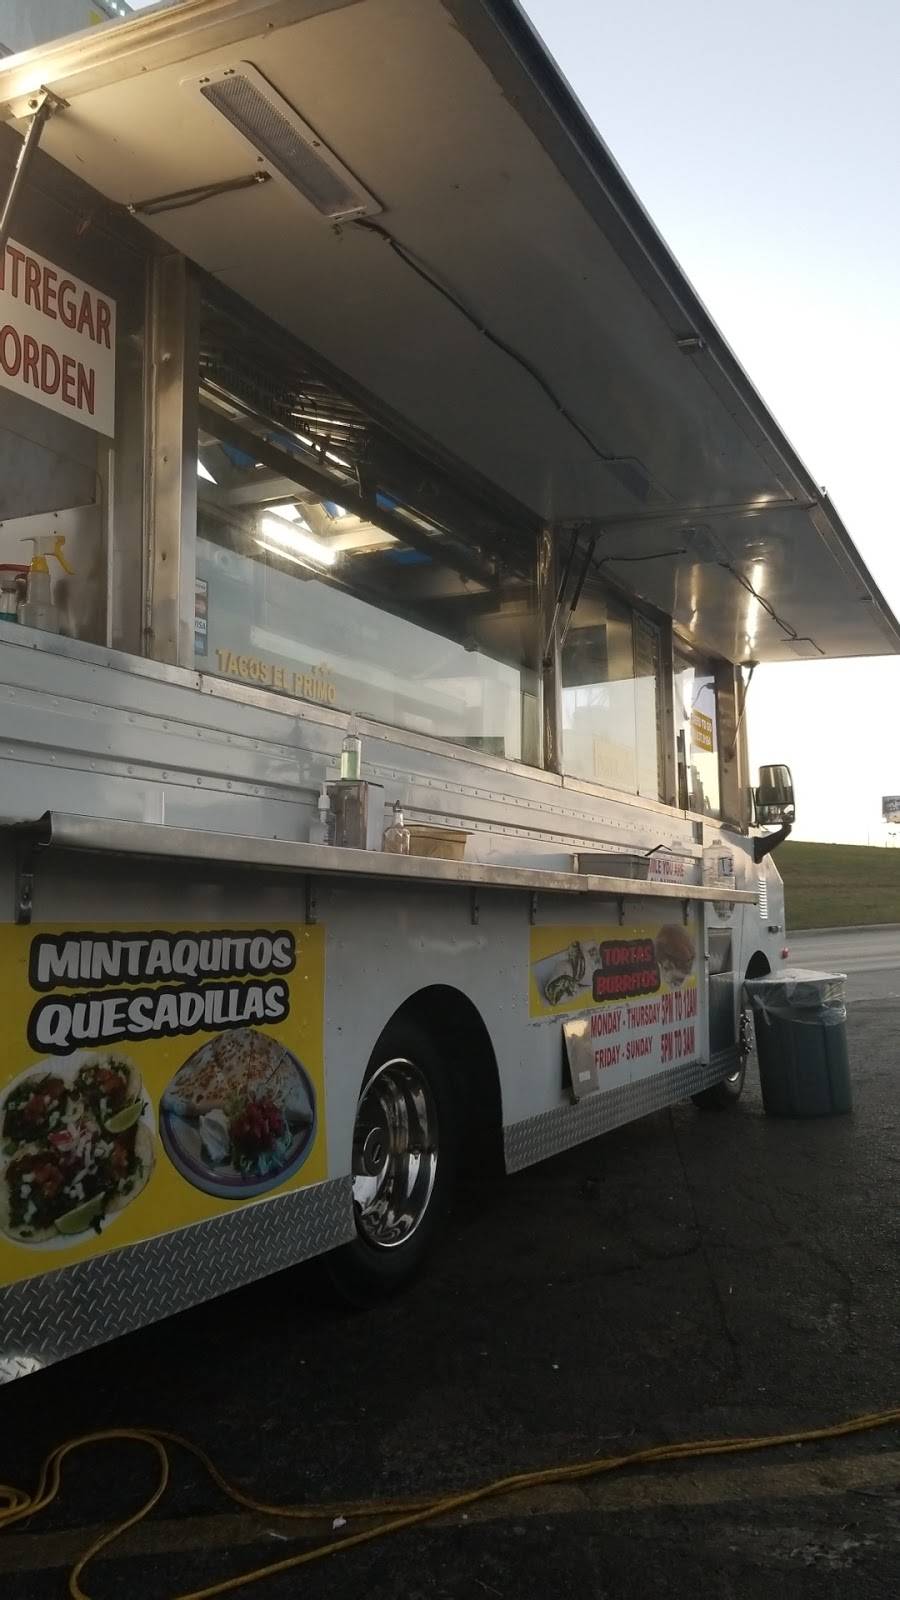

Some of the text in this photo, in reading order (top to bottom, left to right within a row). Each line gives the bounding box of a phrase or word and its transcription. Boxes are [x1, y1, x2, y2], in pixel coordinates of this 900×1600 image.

[0, 325, 95, 415] ORDEN
[216, 649, 336, 704] TACOS EL PRIMO
[37, 936, 292, 983] MINTAQUITOS
[605, 945, 652, 965] TORTAS
[597, 970, 657, 993] BURRITOS
[36, 985, 286, 1047] QUESADILLAS
[591, 1010, 621, 1038] MONDAY
[627, 1003, 660, 1029] THURSDAY
[675, 990, 683, 1021] TO
[595, 1044, 620, 1069] FRIDAY
[626, 1036, 653, 1060] SUNDAY
[674, 1029, 682, 1060] TO
